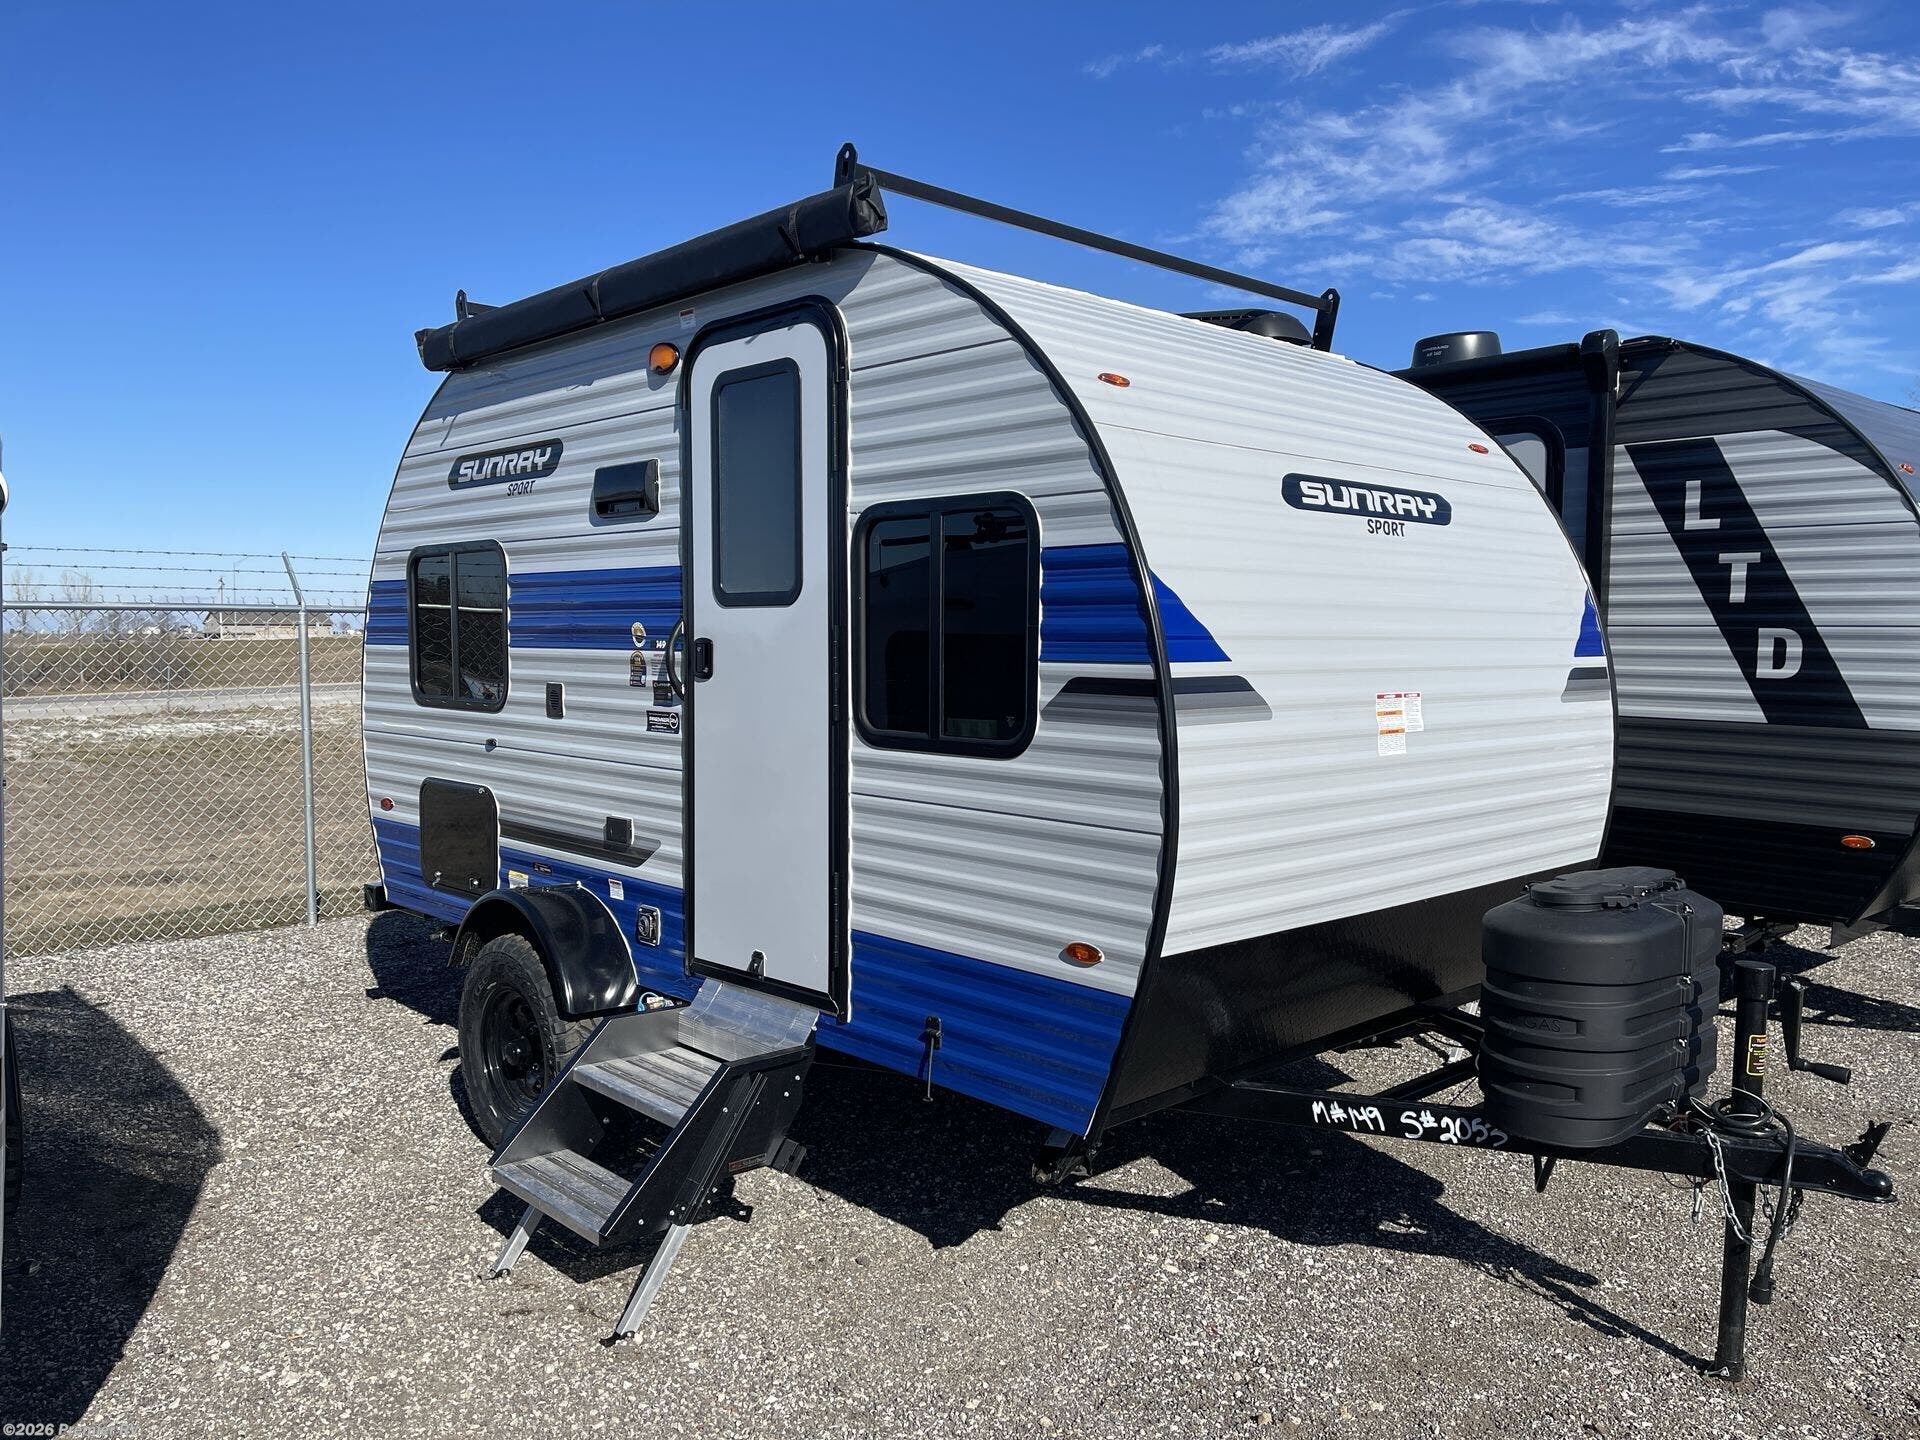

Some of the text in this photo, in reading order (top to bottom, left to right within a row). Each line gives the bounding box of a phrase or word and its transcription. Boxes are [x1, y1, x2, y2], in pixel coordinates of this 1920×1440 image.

[458, 447, 551, 482] SUNRAY
[507, 480, 536, 496] SPORT
[1300, 481, 1437, 518] SUNRAY
[1367, 518, 1405, 537] SPORT
